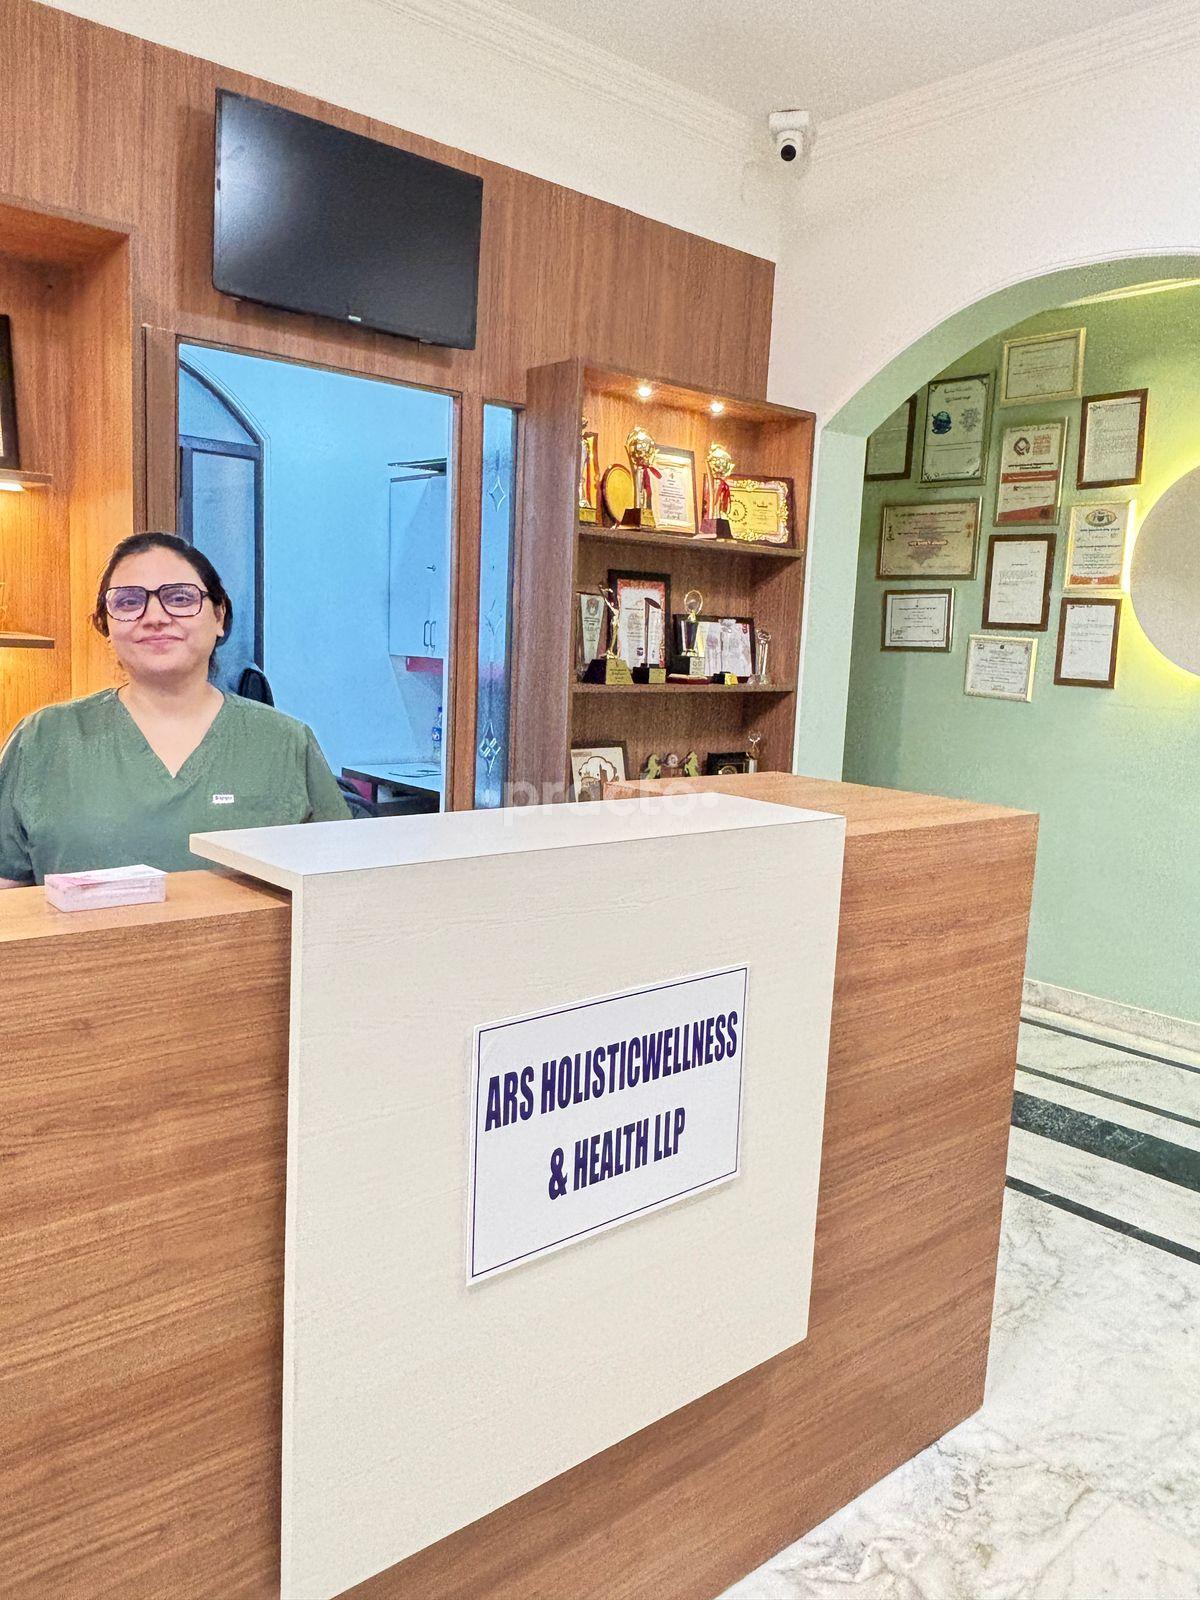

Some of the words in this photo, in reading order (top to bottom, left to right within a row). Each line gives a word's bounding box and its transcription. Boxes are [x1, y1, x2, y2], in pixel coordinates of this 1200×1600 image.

[484, 1065, 535, 1132] ARS
[540, 1010, 738, 1115] HOLISTICWELLNESS
[548, 1147, 567, 1201] &
[573, 1117, 649, 1191] HEALTH
[653, 1107, 686, 1163] LLP
